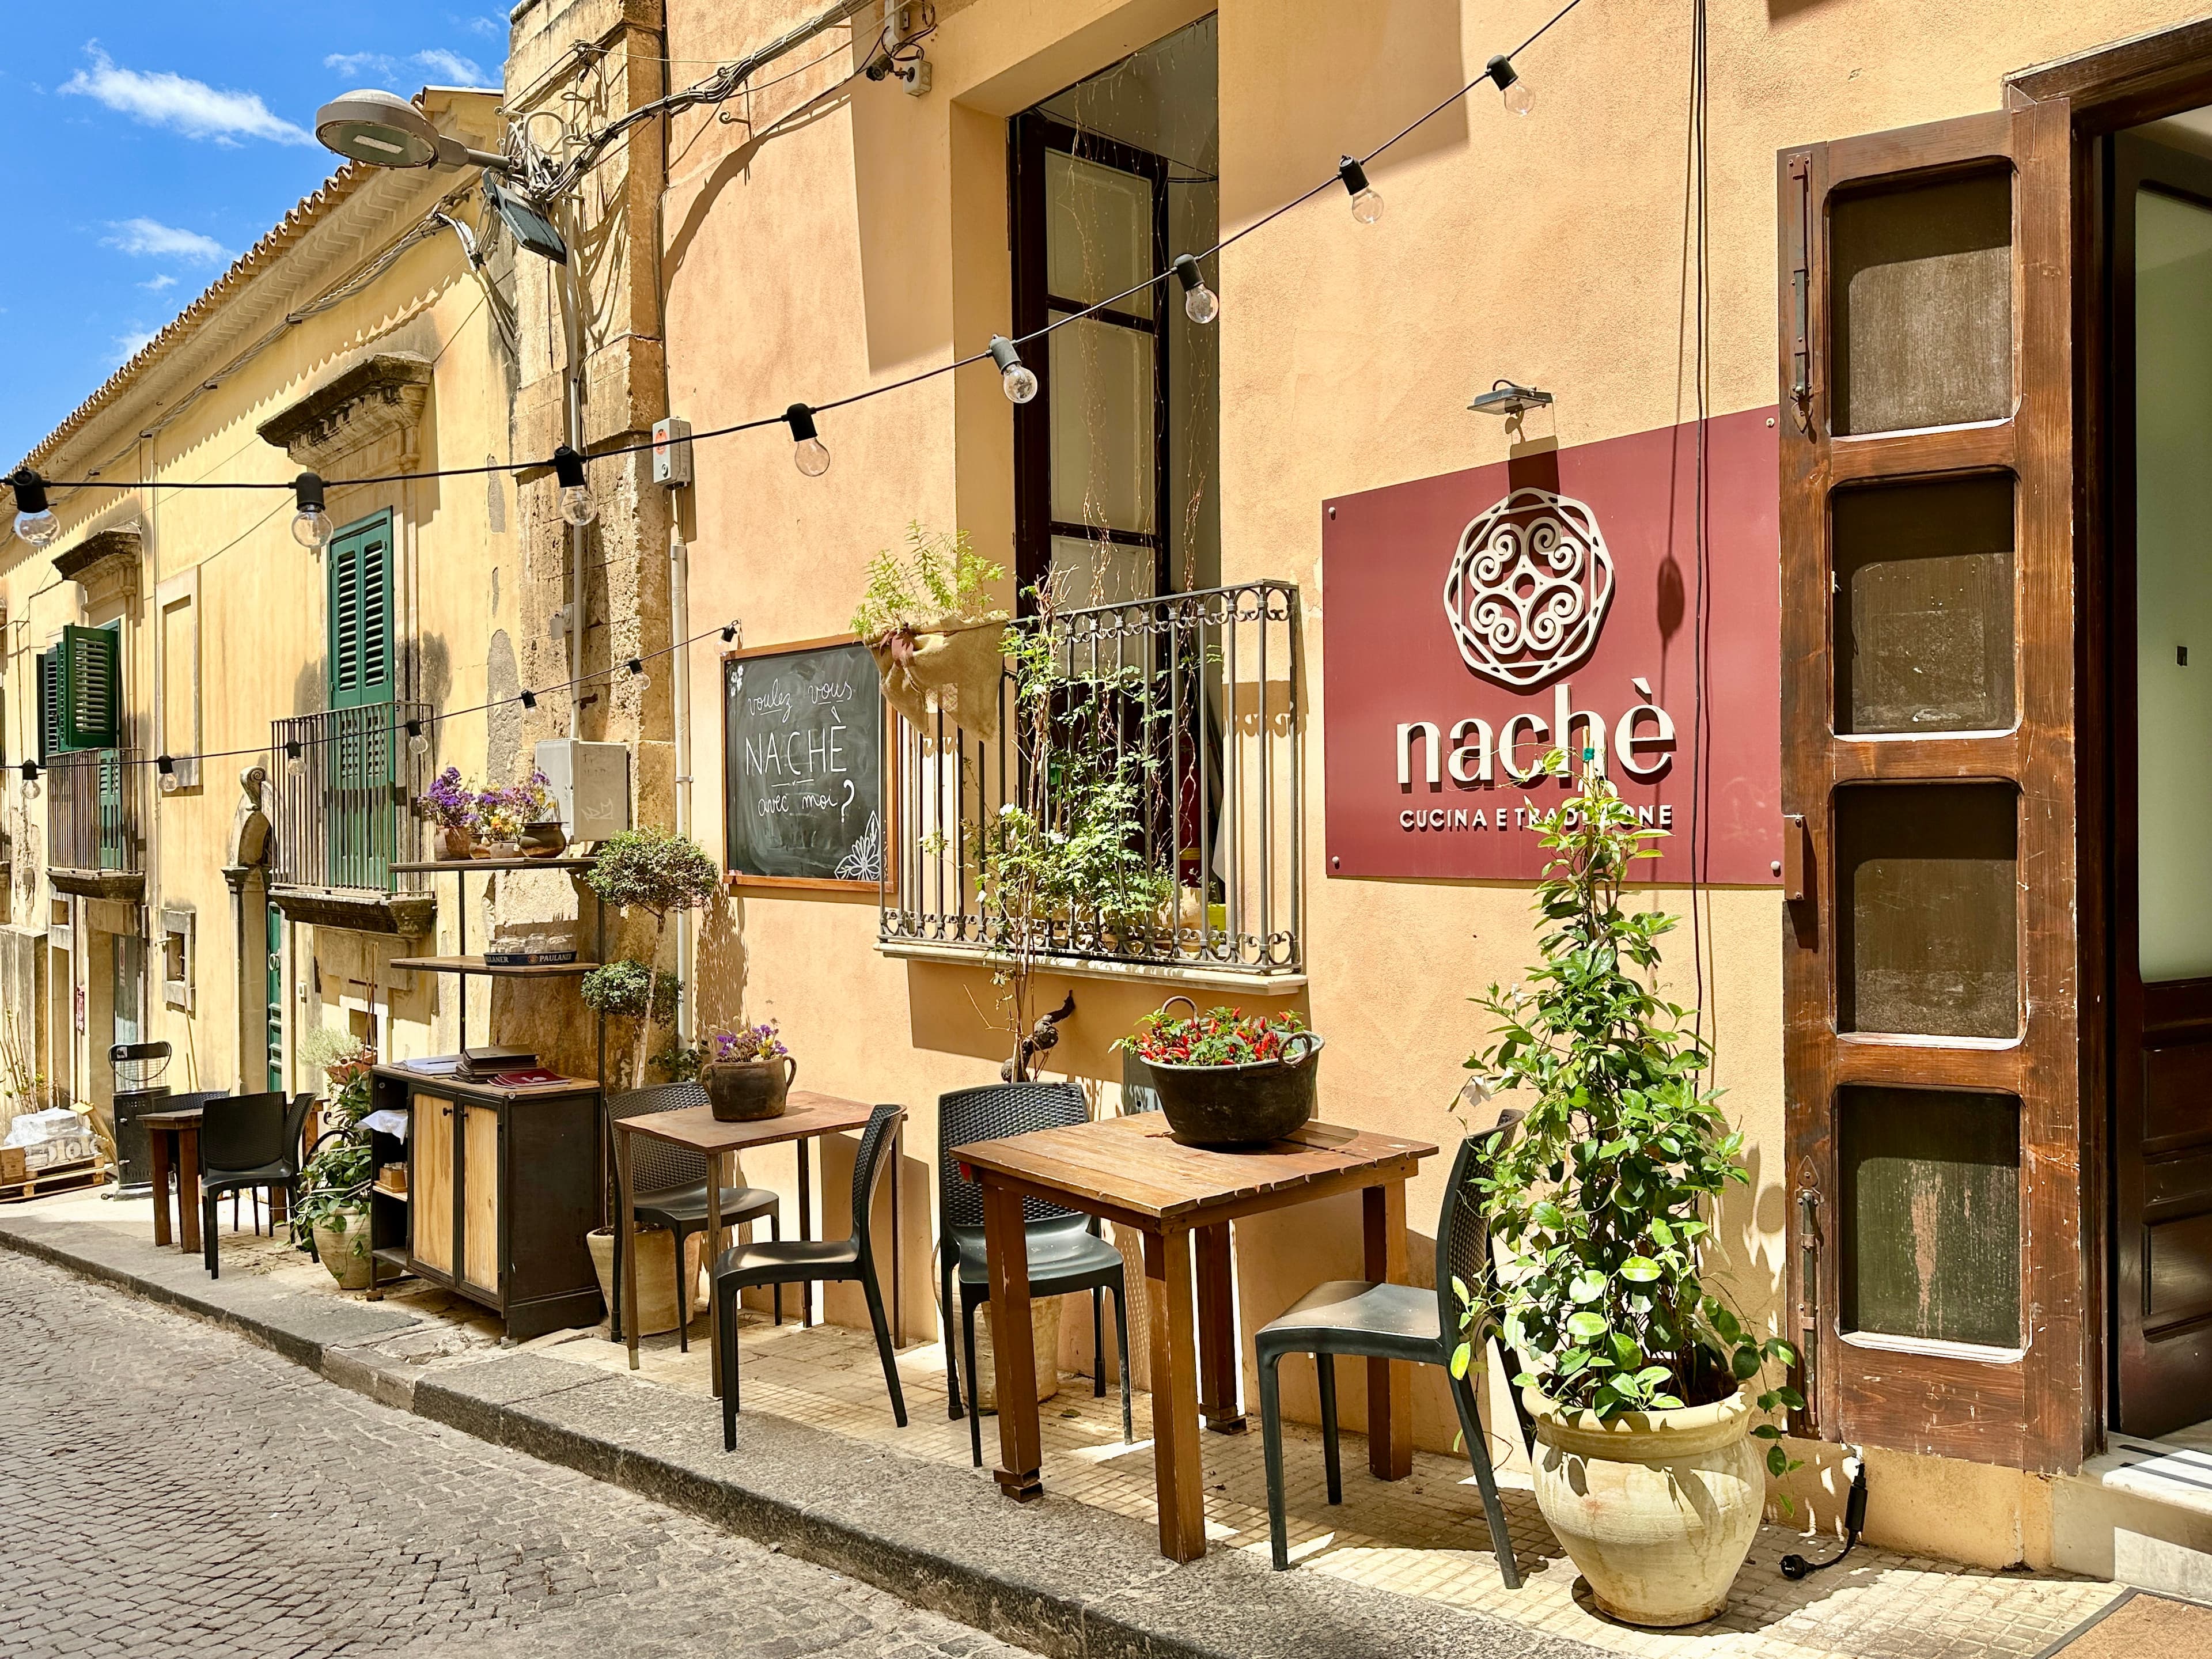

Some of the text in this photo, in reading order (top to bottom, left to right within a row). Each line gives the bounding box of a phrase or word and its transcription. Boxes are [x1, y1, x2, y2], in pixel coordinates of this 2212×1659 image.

[747, 678, 854, 723] voulez vous
[745, 706, 847, 775] NACHÈ
[1396, 677, 1676, 784] nachè
[758, 793, 789, 817] avec
[1399, 808, 1488, 827] CUCINA
[1496, 808, 1508, 826] E
[539, 954, 572, 963] PAULANER
